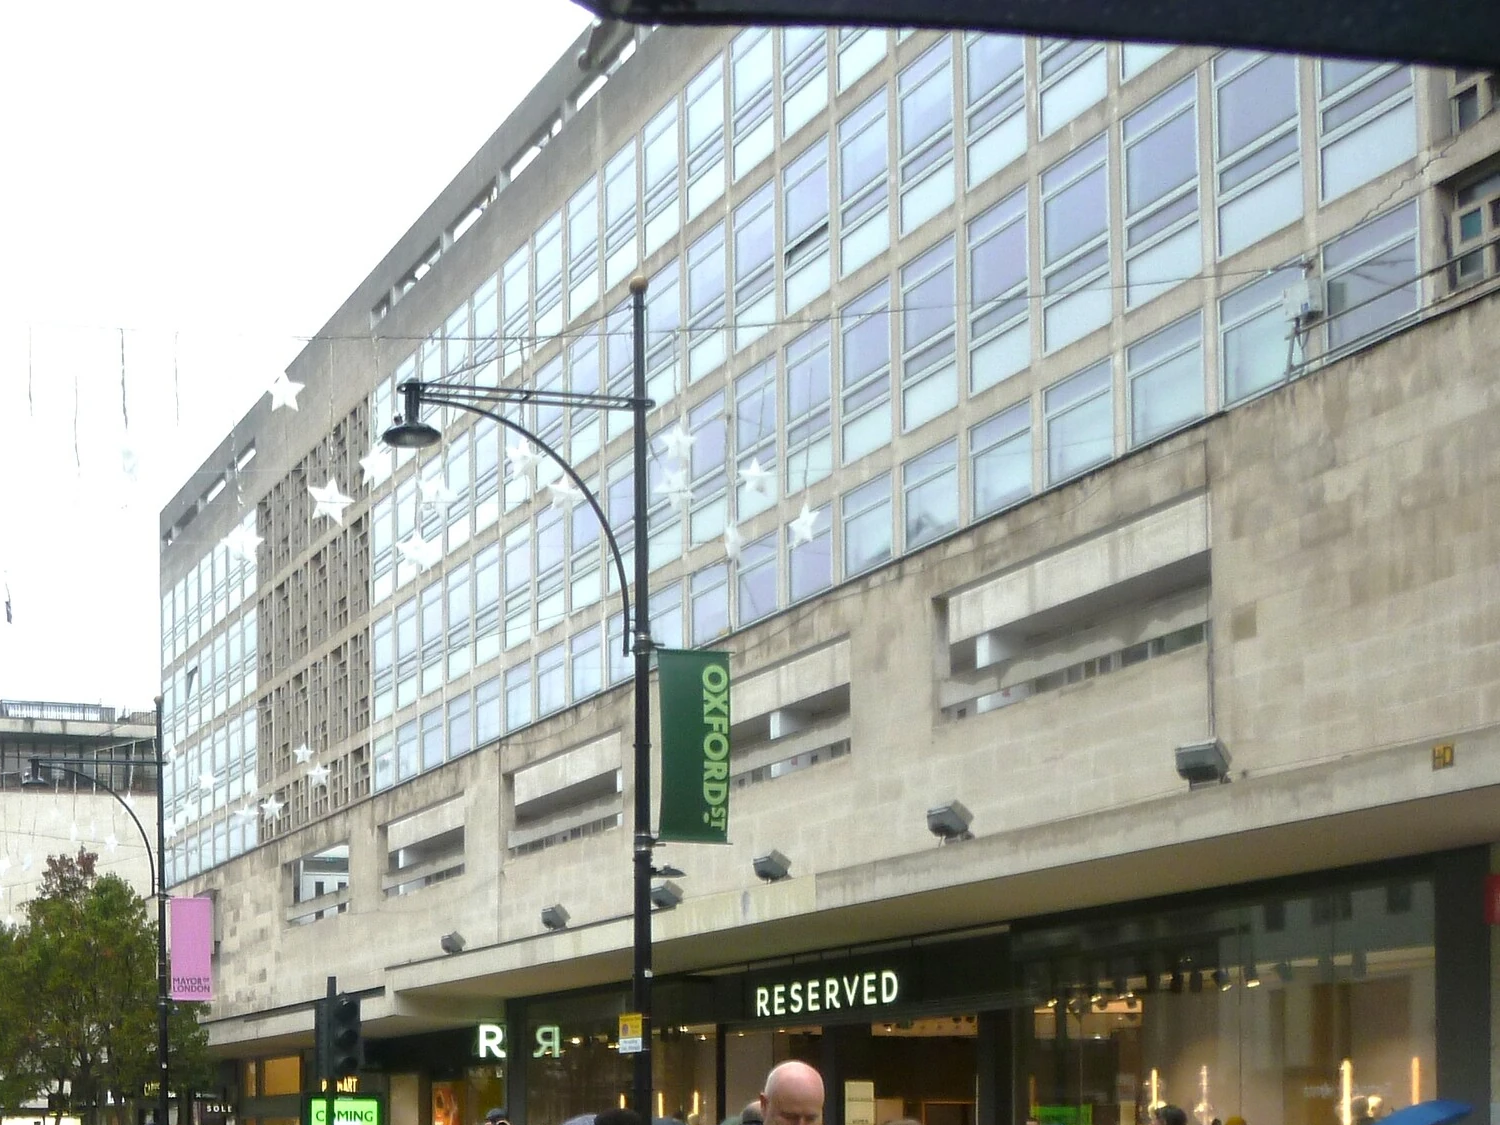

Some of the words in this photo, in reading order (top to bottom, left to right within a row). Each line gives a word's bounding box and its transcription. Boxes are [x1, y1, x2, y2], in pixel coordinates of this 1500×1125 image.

[702, 664, 729, 806] OXFORD
[173, 977, 202, 985] MAYOR
[756, 969, 899, 1017] RESERVED
[479, 1023, 506, 1058] R
[315, 1110, 374, 1123] CMING
